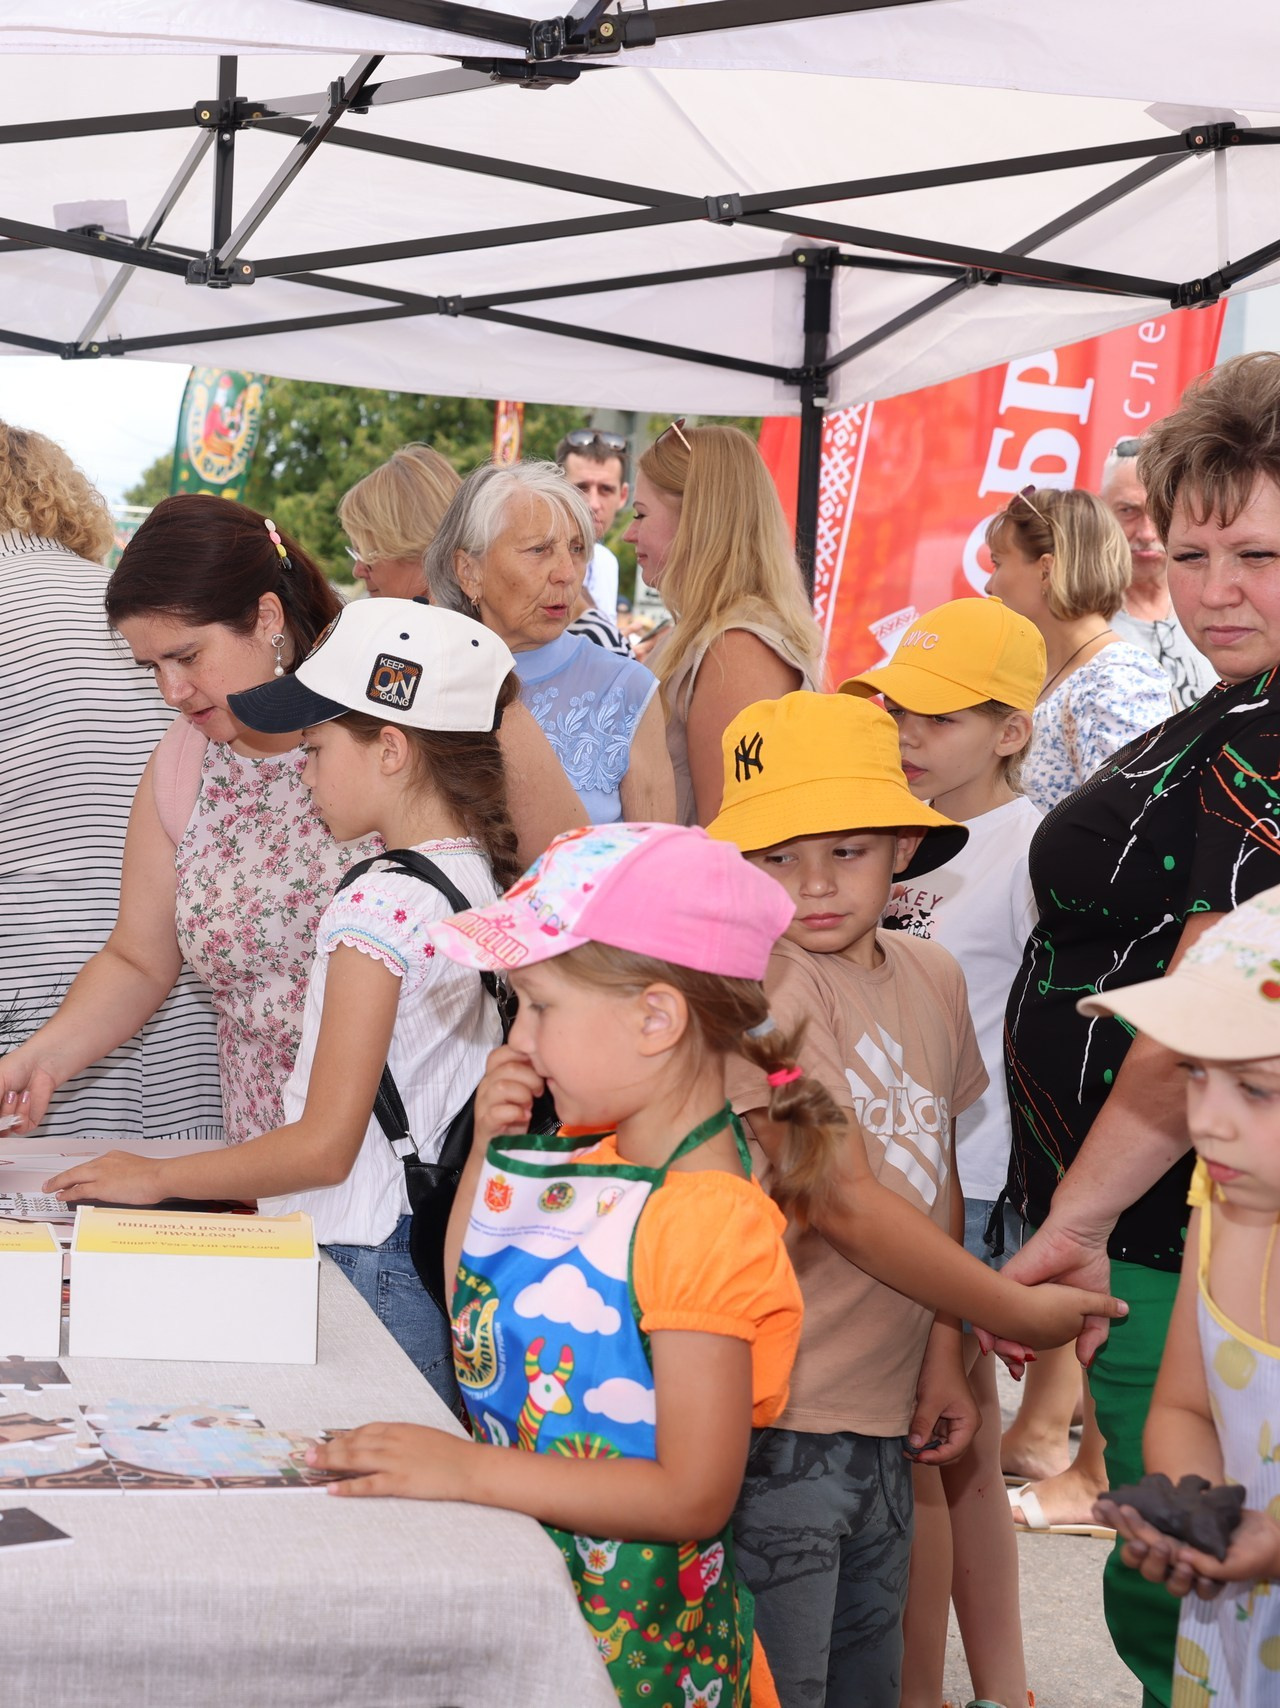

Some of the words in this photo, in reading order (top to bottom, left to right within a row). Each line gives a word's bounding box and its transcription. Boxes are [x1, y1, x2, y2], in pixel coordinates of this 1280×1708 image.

[903, 629, 939, 650] NYC
[379, 657, 406, 671] KEEP
[373, 666, 417, 699] ON
[379, 690, 410, 707] GOING
[899, 886, 944, 910] KEY
[476, 926, 529, 969] CLUB
